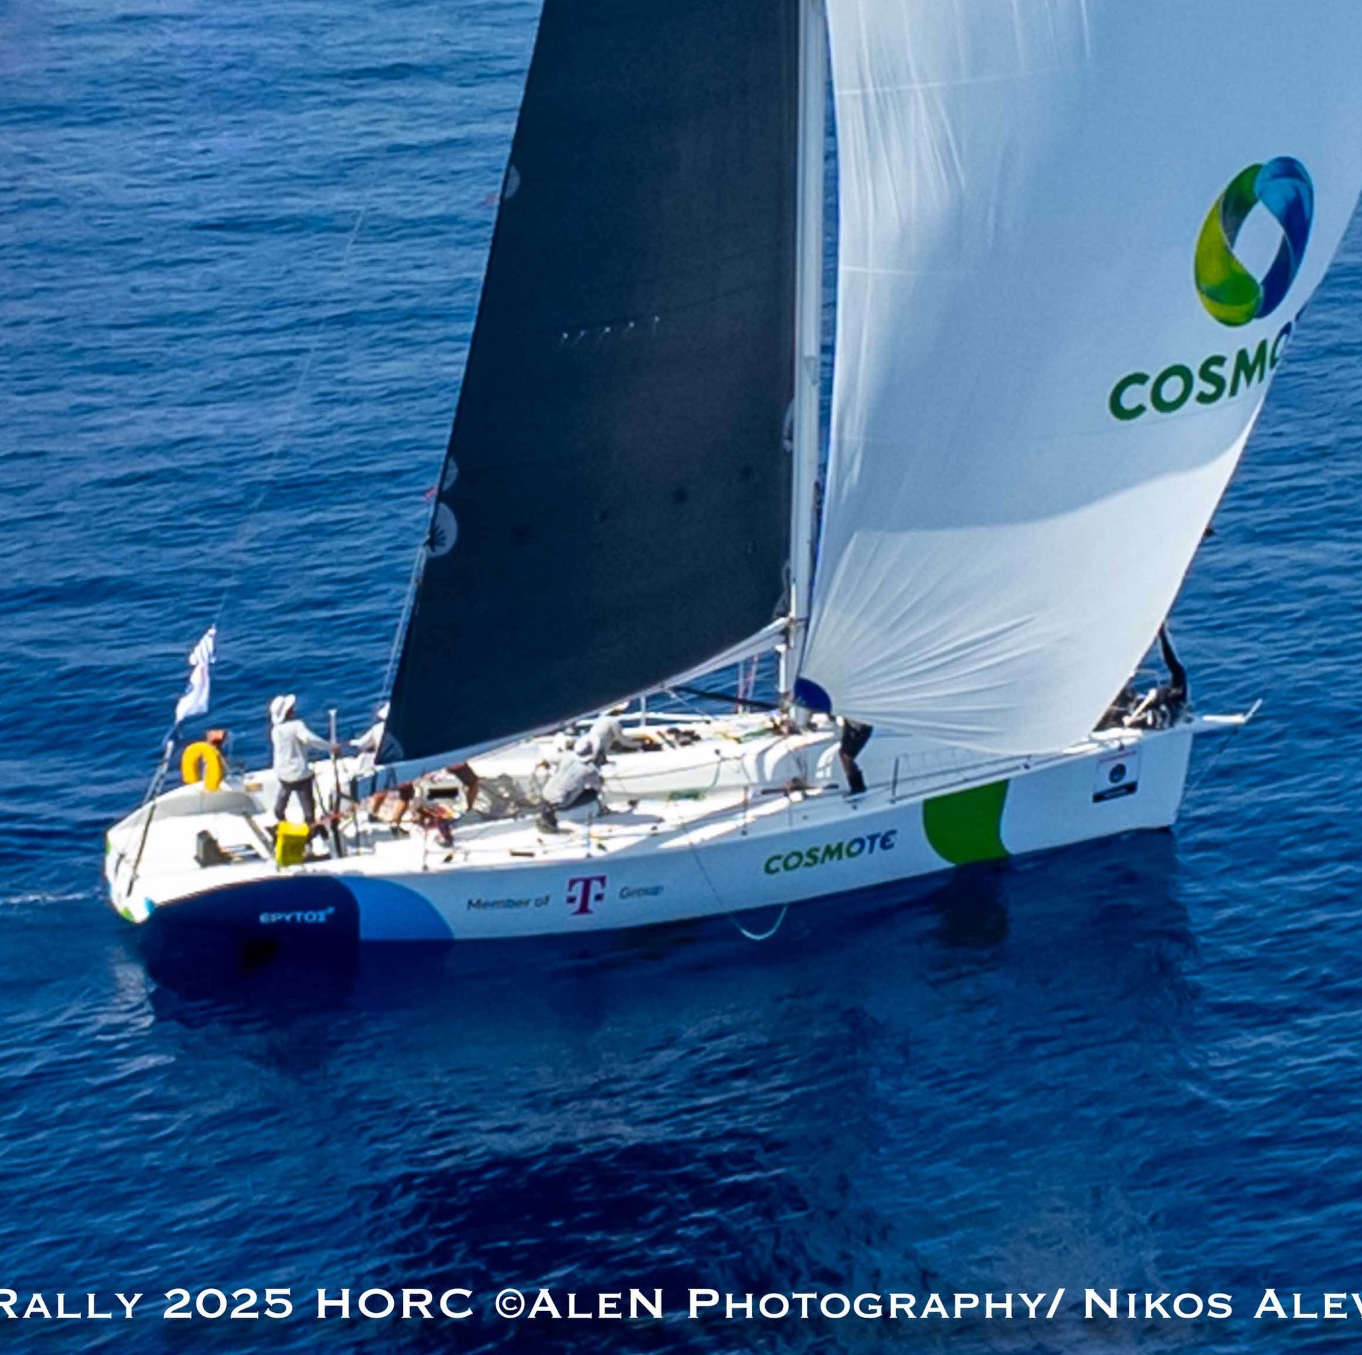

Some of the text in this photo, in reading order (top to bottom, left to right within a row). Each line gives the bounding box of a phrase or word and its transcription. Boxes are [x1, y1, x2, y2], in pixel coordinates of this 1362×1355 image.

[764, 829, 897, 874] COSMOTE
[466, 896, 530, 911] Member
[534, 894, 550, 908] of
